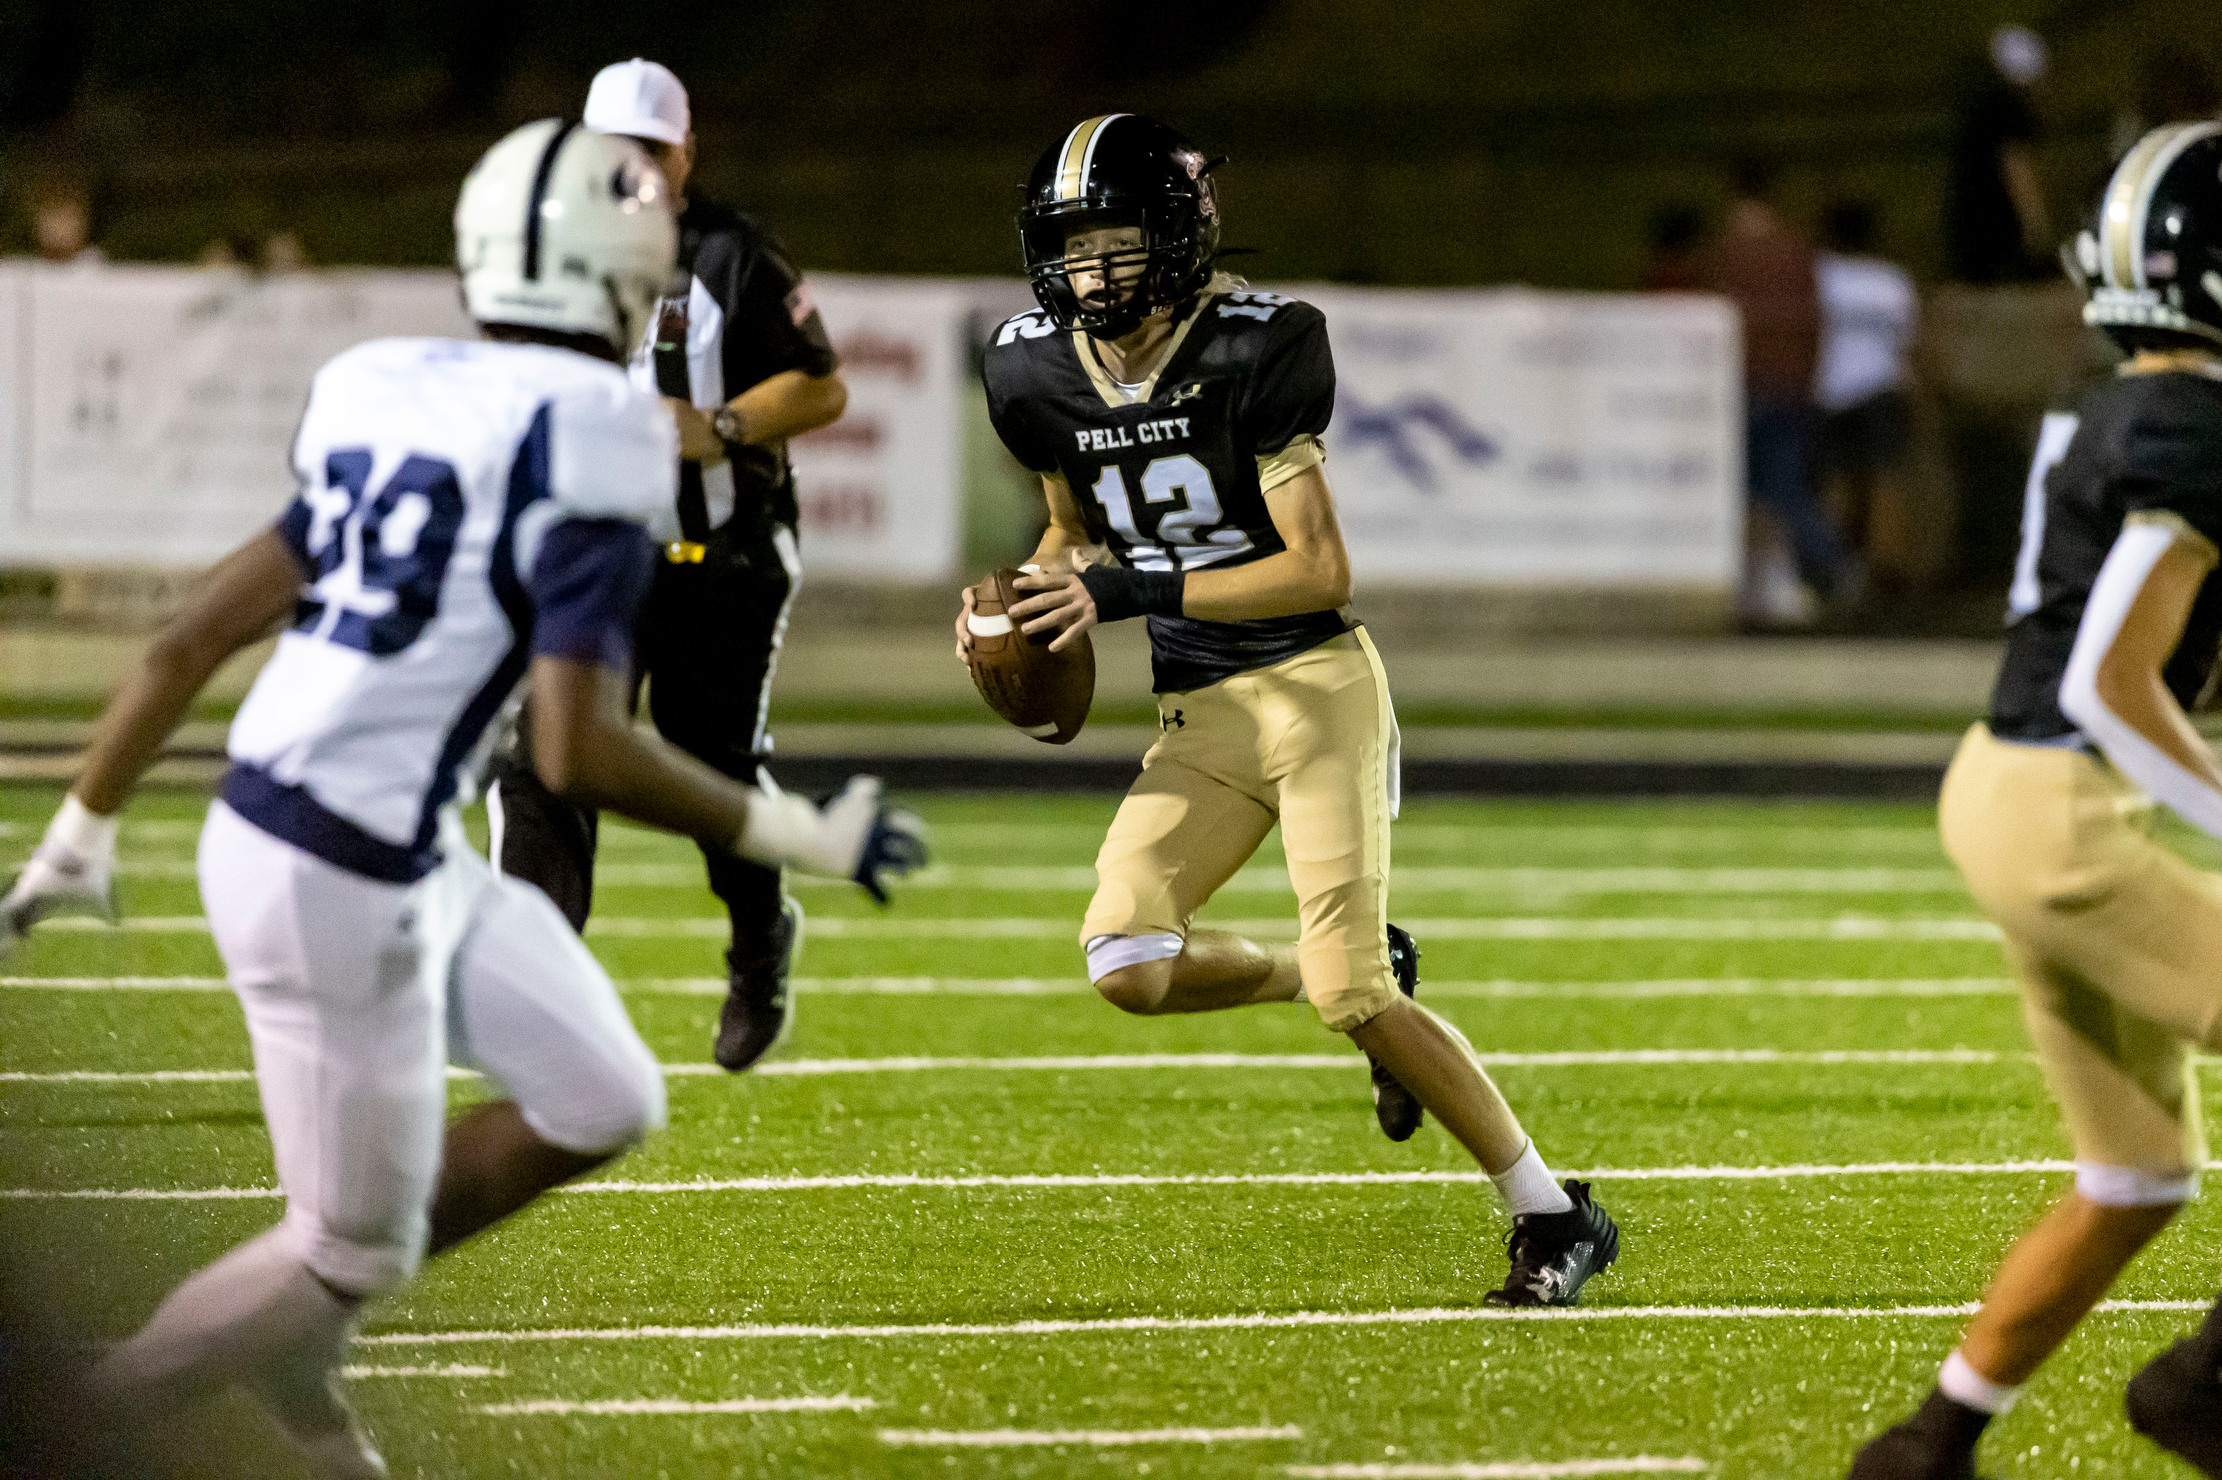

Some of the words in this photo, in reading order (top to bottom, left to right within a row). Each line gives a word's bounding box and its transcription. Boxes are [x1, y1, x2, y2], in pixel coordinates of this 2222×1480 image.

[1075, 426, 1135, 452] PELL
[1136, 417, 1191, 444] CITY
[1091, 453, 1256, 572] 12
